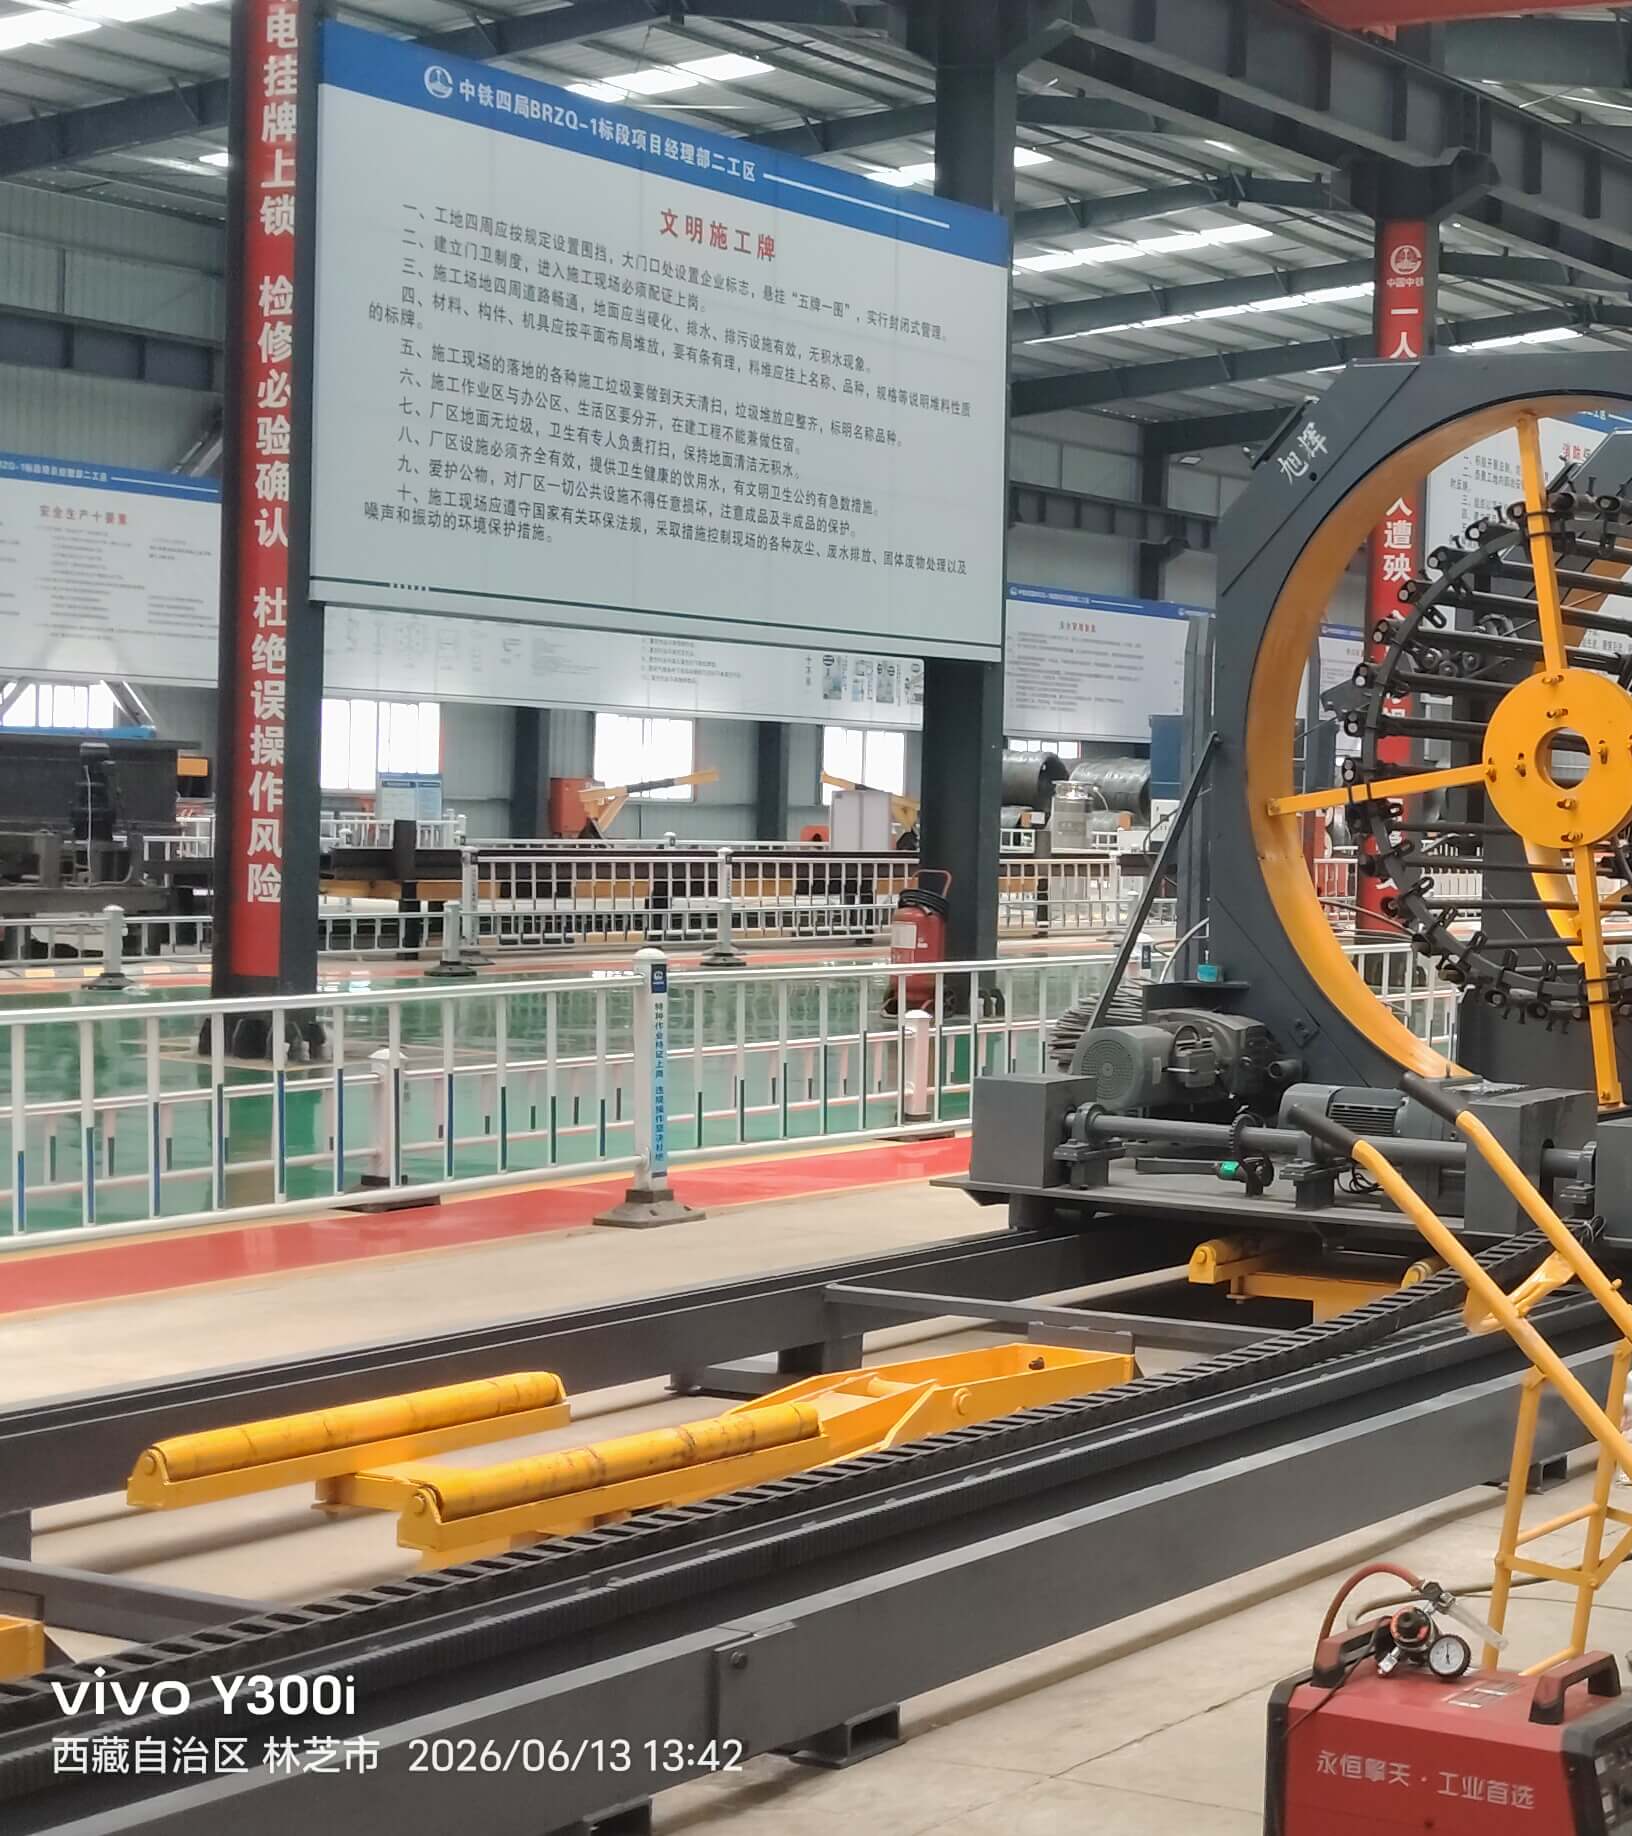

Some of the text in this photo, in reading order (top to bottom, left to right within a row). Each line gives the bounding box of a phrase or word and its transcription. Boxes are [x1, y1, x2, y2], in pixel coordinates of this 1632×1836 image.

[459, 78, 757, 183] 中铁四局BRZQ-1标段项目经理部二工区
[659, 207, 777, 263] 文明施工牌
[368, 300, 424, 330] 的标牌。
[246, 0, 298, 905] 电挂牌上锁 检修必验确认 杜绝误操作风险
[1278, 420, 1330, 486] 旭辉
[364, 500, 554, 544] 噪声和振动的环境保护措施。
